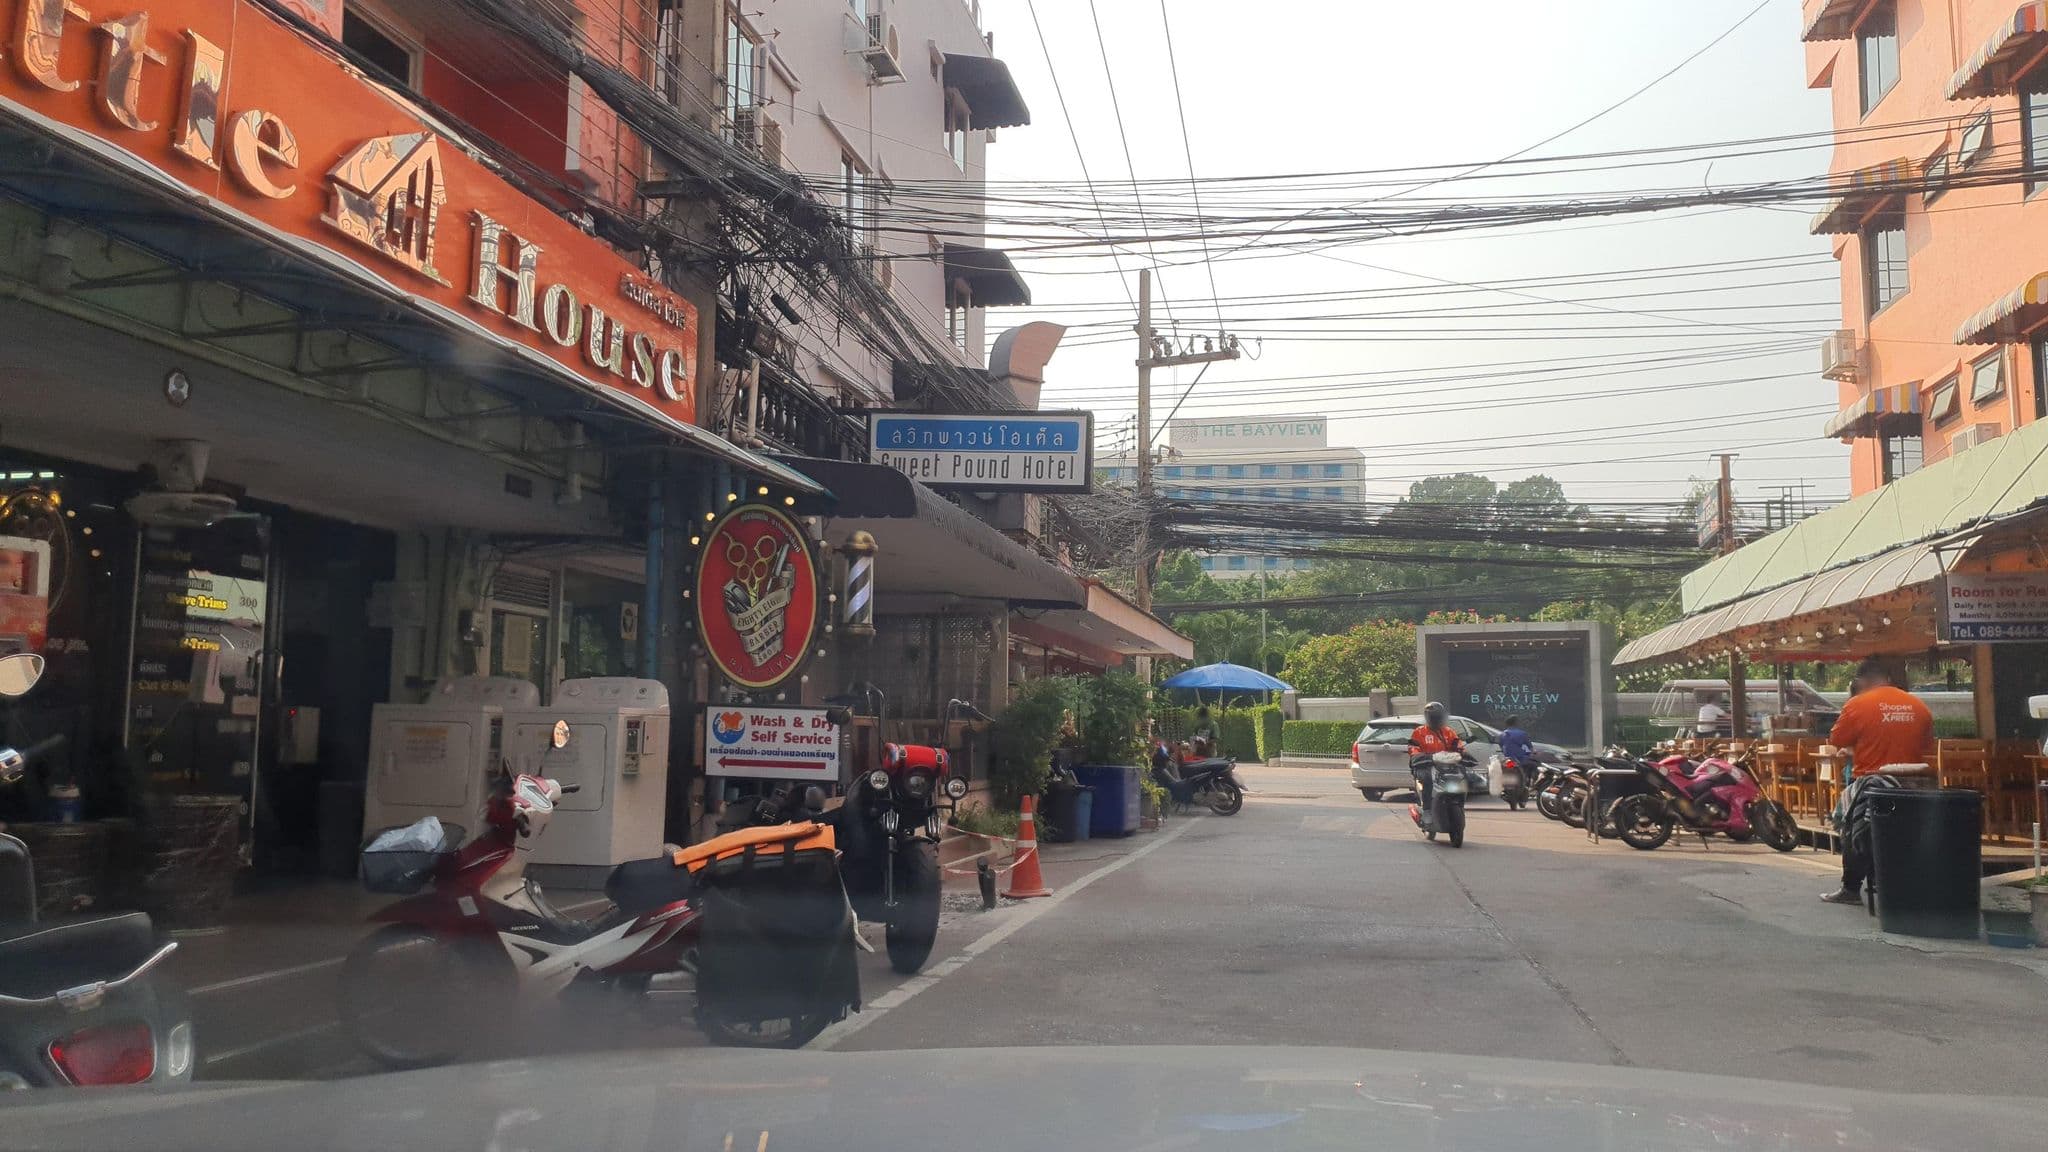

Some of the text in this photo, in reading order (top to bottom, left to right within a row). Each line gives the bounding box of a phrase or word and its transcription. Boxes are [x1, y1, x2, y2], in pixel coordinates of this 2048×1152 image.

[467, 208, 688, 402] House
[1202, 423, 1324, 437] THE BAYVIEW
[953, 455, 1010, 479] Pound
[1023, 456, 1074, 480] Hotel
[1951, 586, 1994, 598] Room
[762, 597, 785, 613] EIG
[1952, 625, 1974, 638] Tel.
[1502, 685, 1530, 693] THE
[1470, 693, 1560, 704] BAYVIEW
[750, 714, 834, 732] Wash & Dry
[751, 731, 832, 745] Self Service
